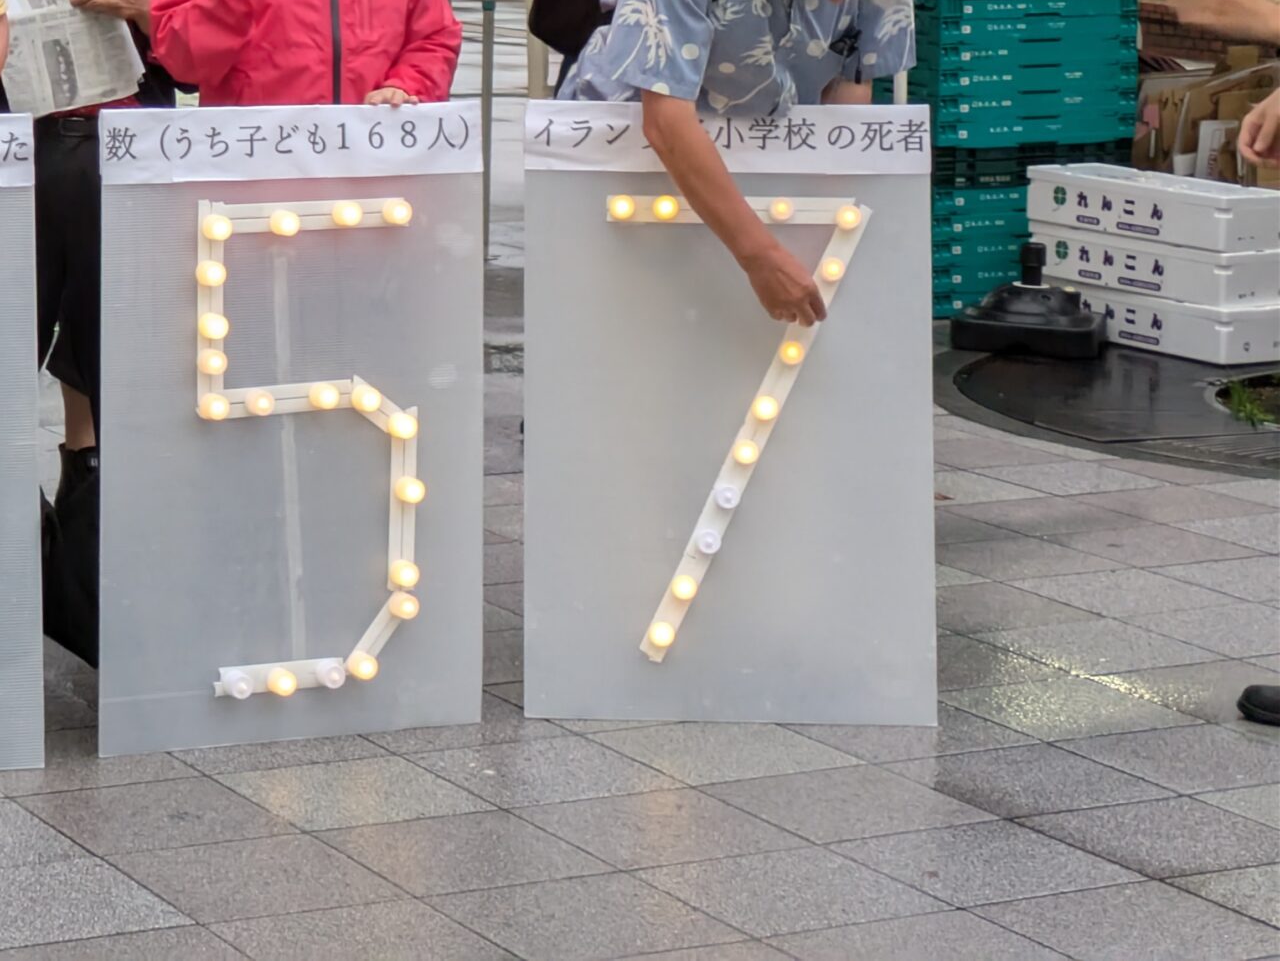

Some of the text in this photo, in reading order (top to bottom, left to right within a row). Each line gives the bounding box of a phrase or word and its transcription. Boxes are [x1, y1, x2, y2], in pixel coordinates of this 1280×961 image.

[534, 116, 929, 152] イラン小学校の死者
[1077, 191, 1163, 221] れんこん
[1079, 246, 1164, 277] れんこん
[606, 192, 873, 665] 7
[196, 197, 426, 700] 5
